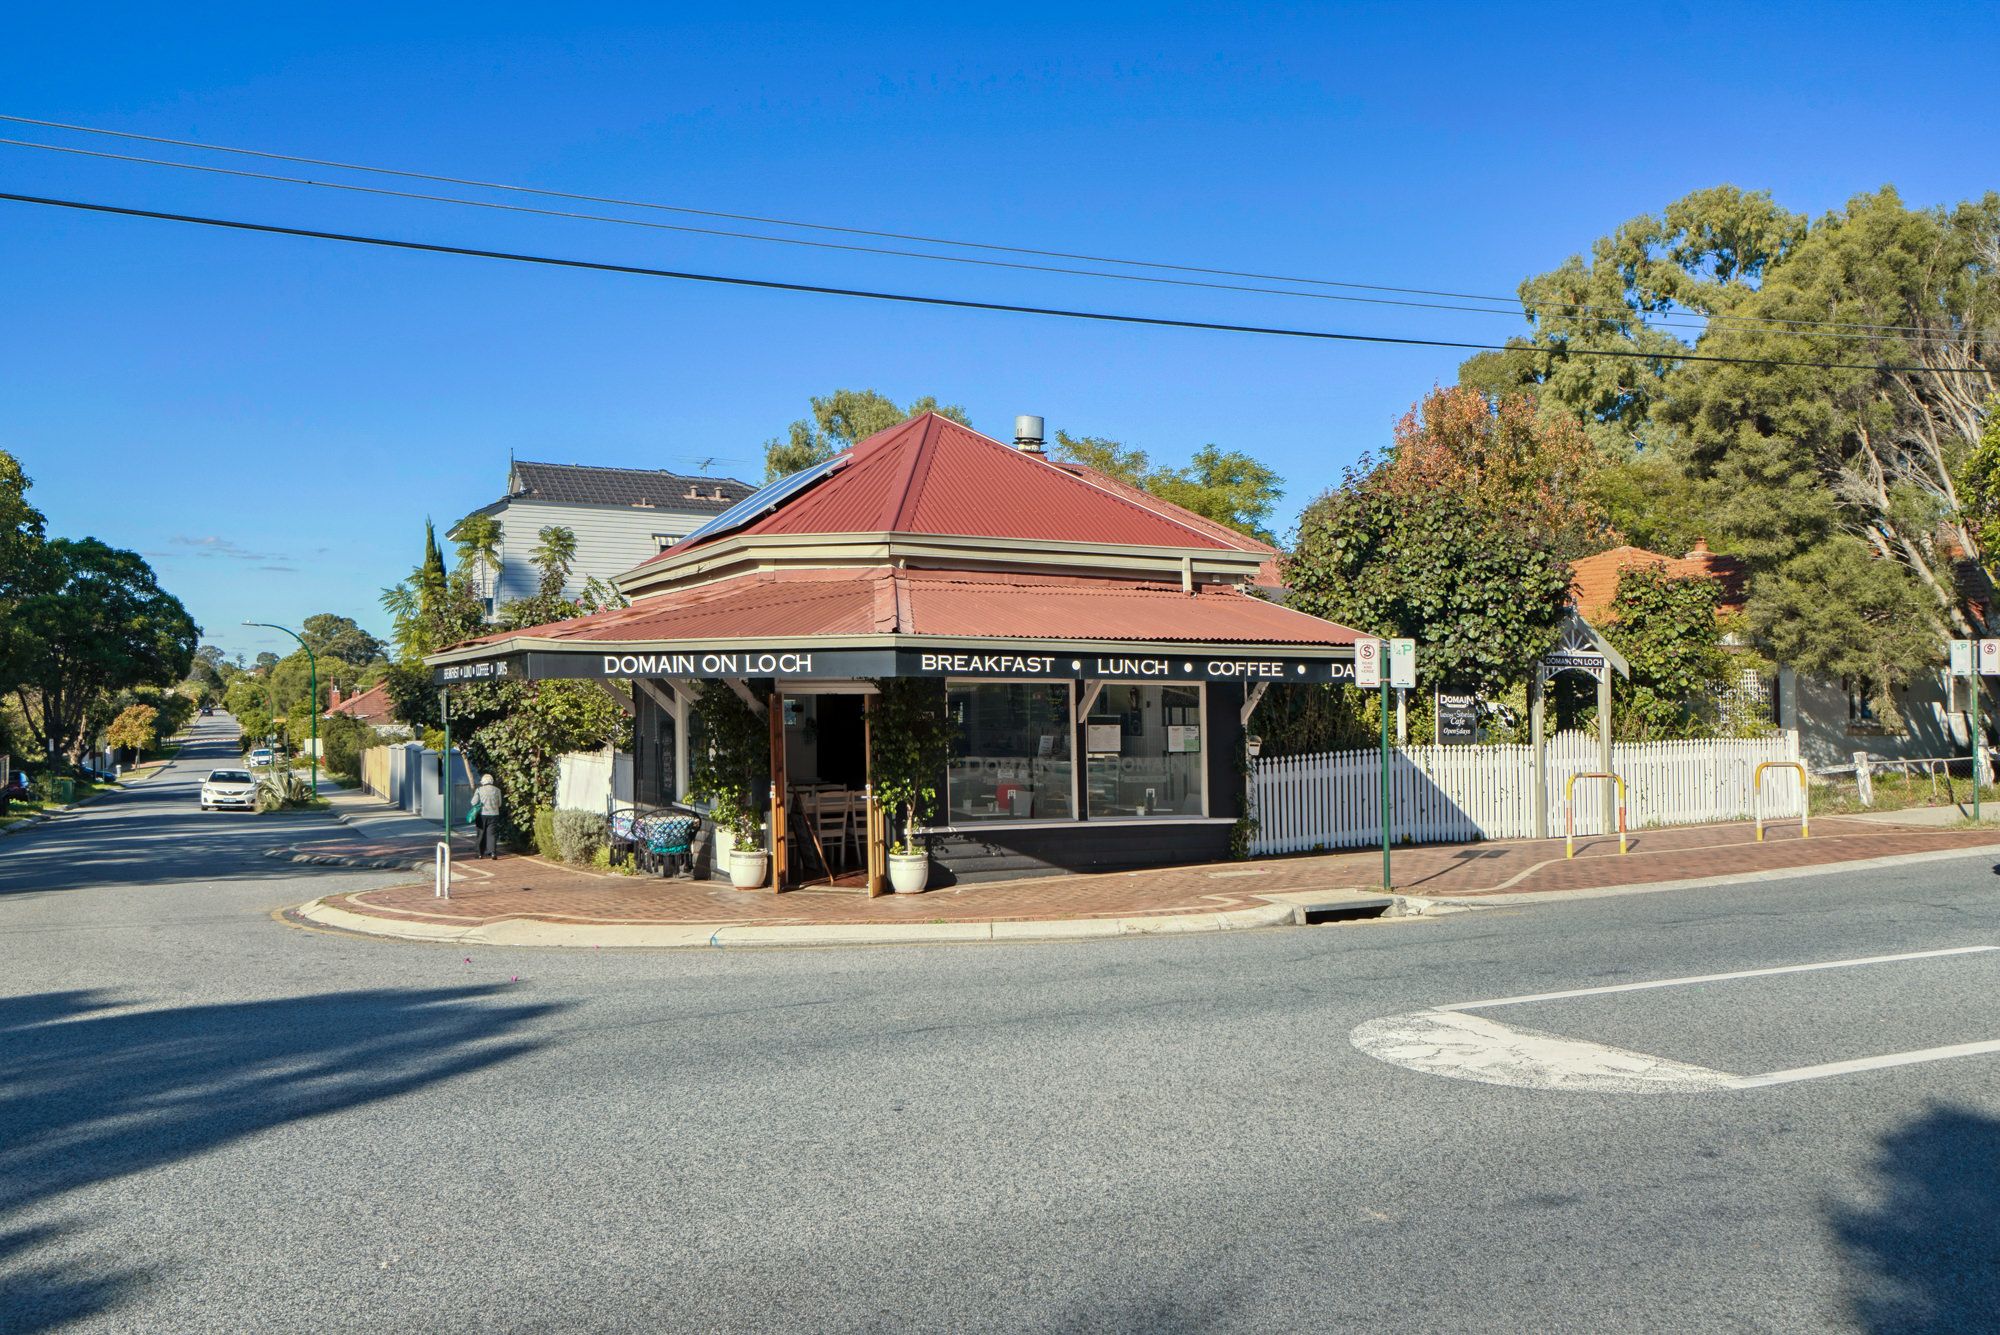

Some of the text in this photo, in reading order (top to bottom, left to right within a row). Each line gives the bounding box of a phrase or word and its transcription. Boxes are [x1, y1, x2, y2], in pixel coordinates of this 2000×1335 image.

[604, 654, 812, 674] DOMAIN ON LOCH
[921, 654, 1356, 677] BREAKFAST LUNCH COFFEE DA
[1546, 657, 1571, 666] DOMAIN
[1584, 658, 1602, 666] LOCH
[1440, 694, 1475, 705] DOMAIN
